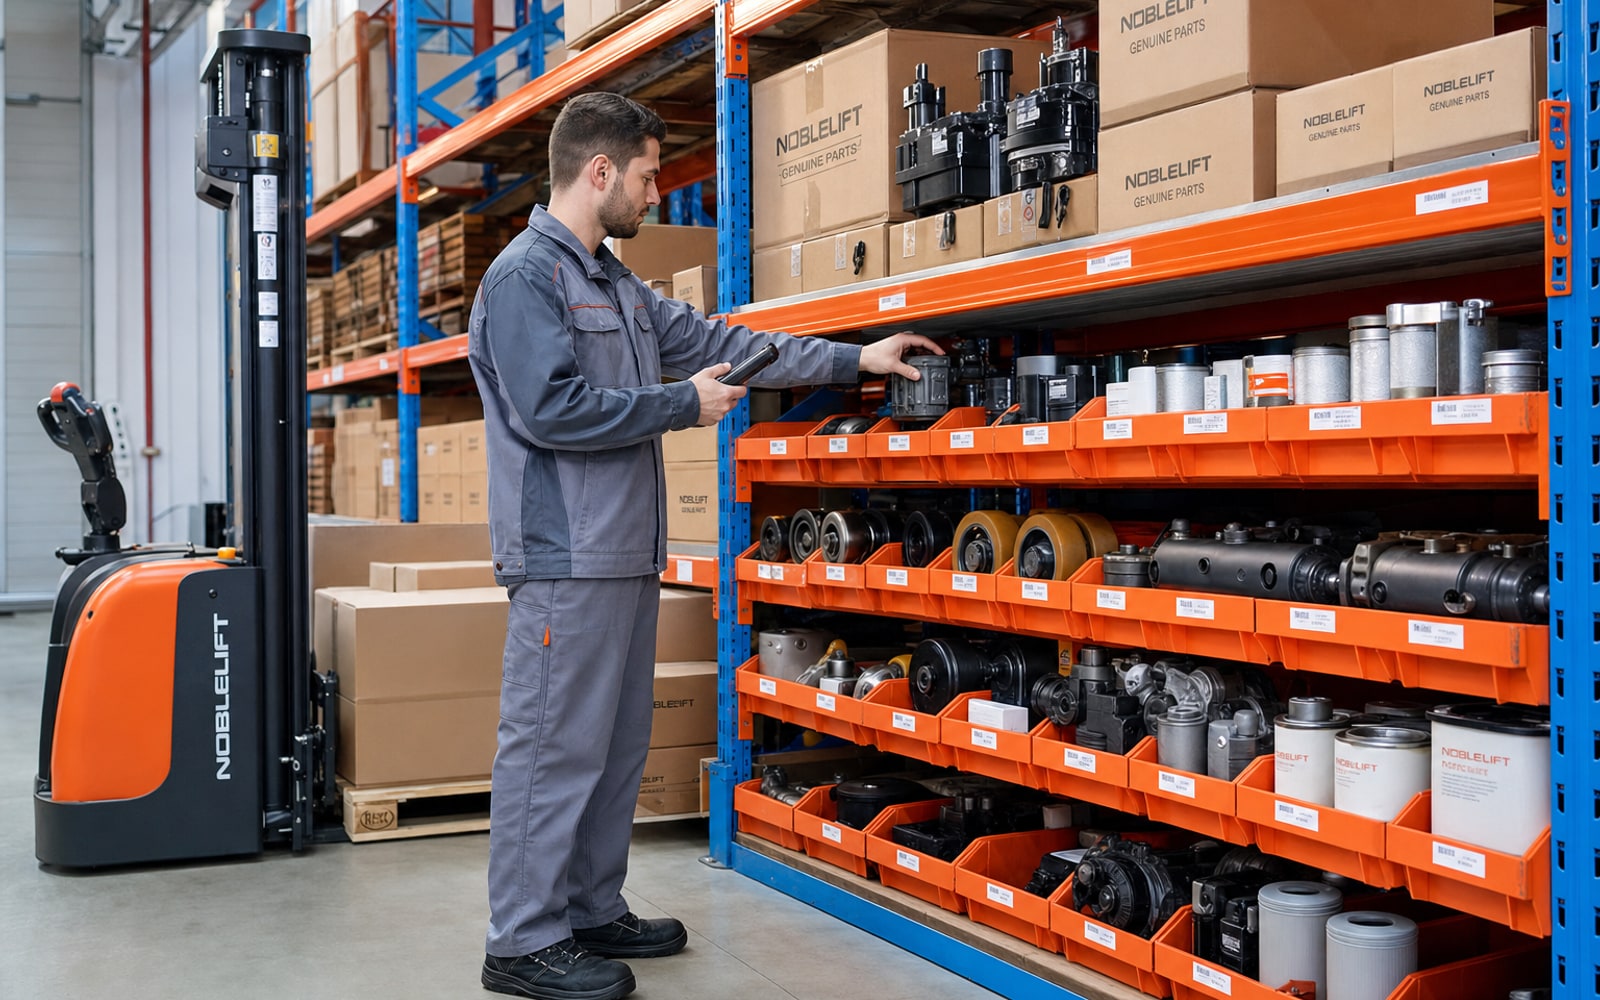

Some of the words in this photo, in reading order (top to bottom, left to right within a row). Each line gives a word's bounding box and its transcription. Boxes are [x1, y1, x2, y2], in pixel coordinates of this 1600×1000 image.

[1129, 29, 1173, 54] GENUINE
[1174, 18, 1206, 41] PARTS
[1424, 69, 1495, 97] NOBLELIFT
[1465, 90, 1490, 103] PARTS
[776, 104, 863, 157] NOBLELIFT
[1303, 103, 1366, 129] NOBLELIFT
[781, 155, 824, 179] GENUINE
[825, 143, 858, 164] PARTS
[1125, 154, 1212, 191] NOBLELIFT
[1134, 189, 1174, 208] GENUINE
[1176, 182, 1205, 199] PARTS
[213, 612, 231, 780] NOBLELIFT
[1441, 746, 1511, 767] NOBLELIFT
